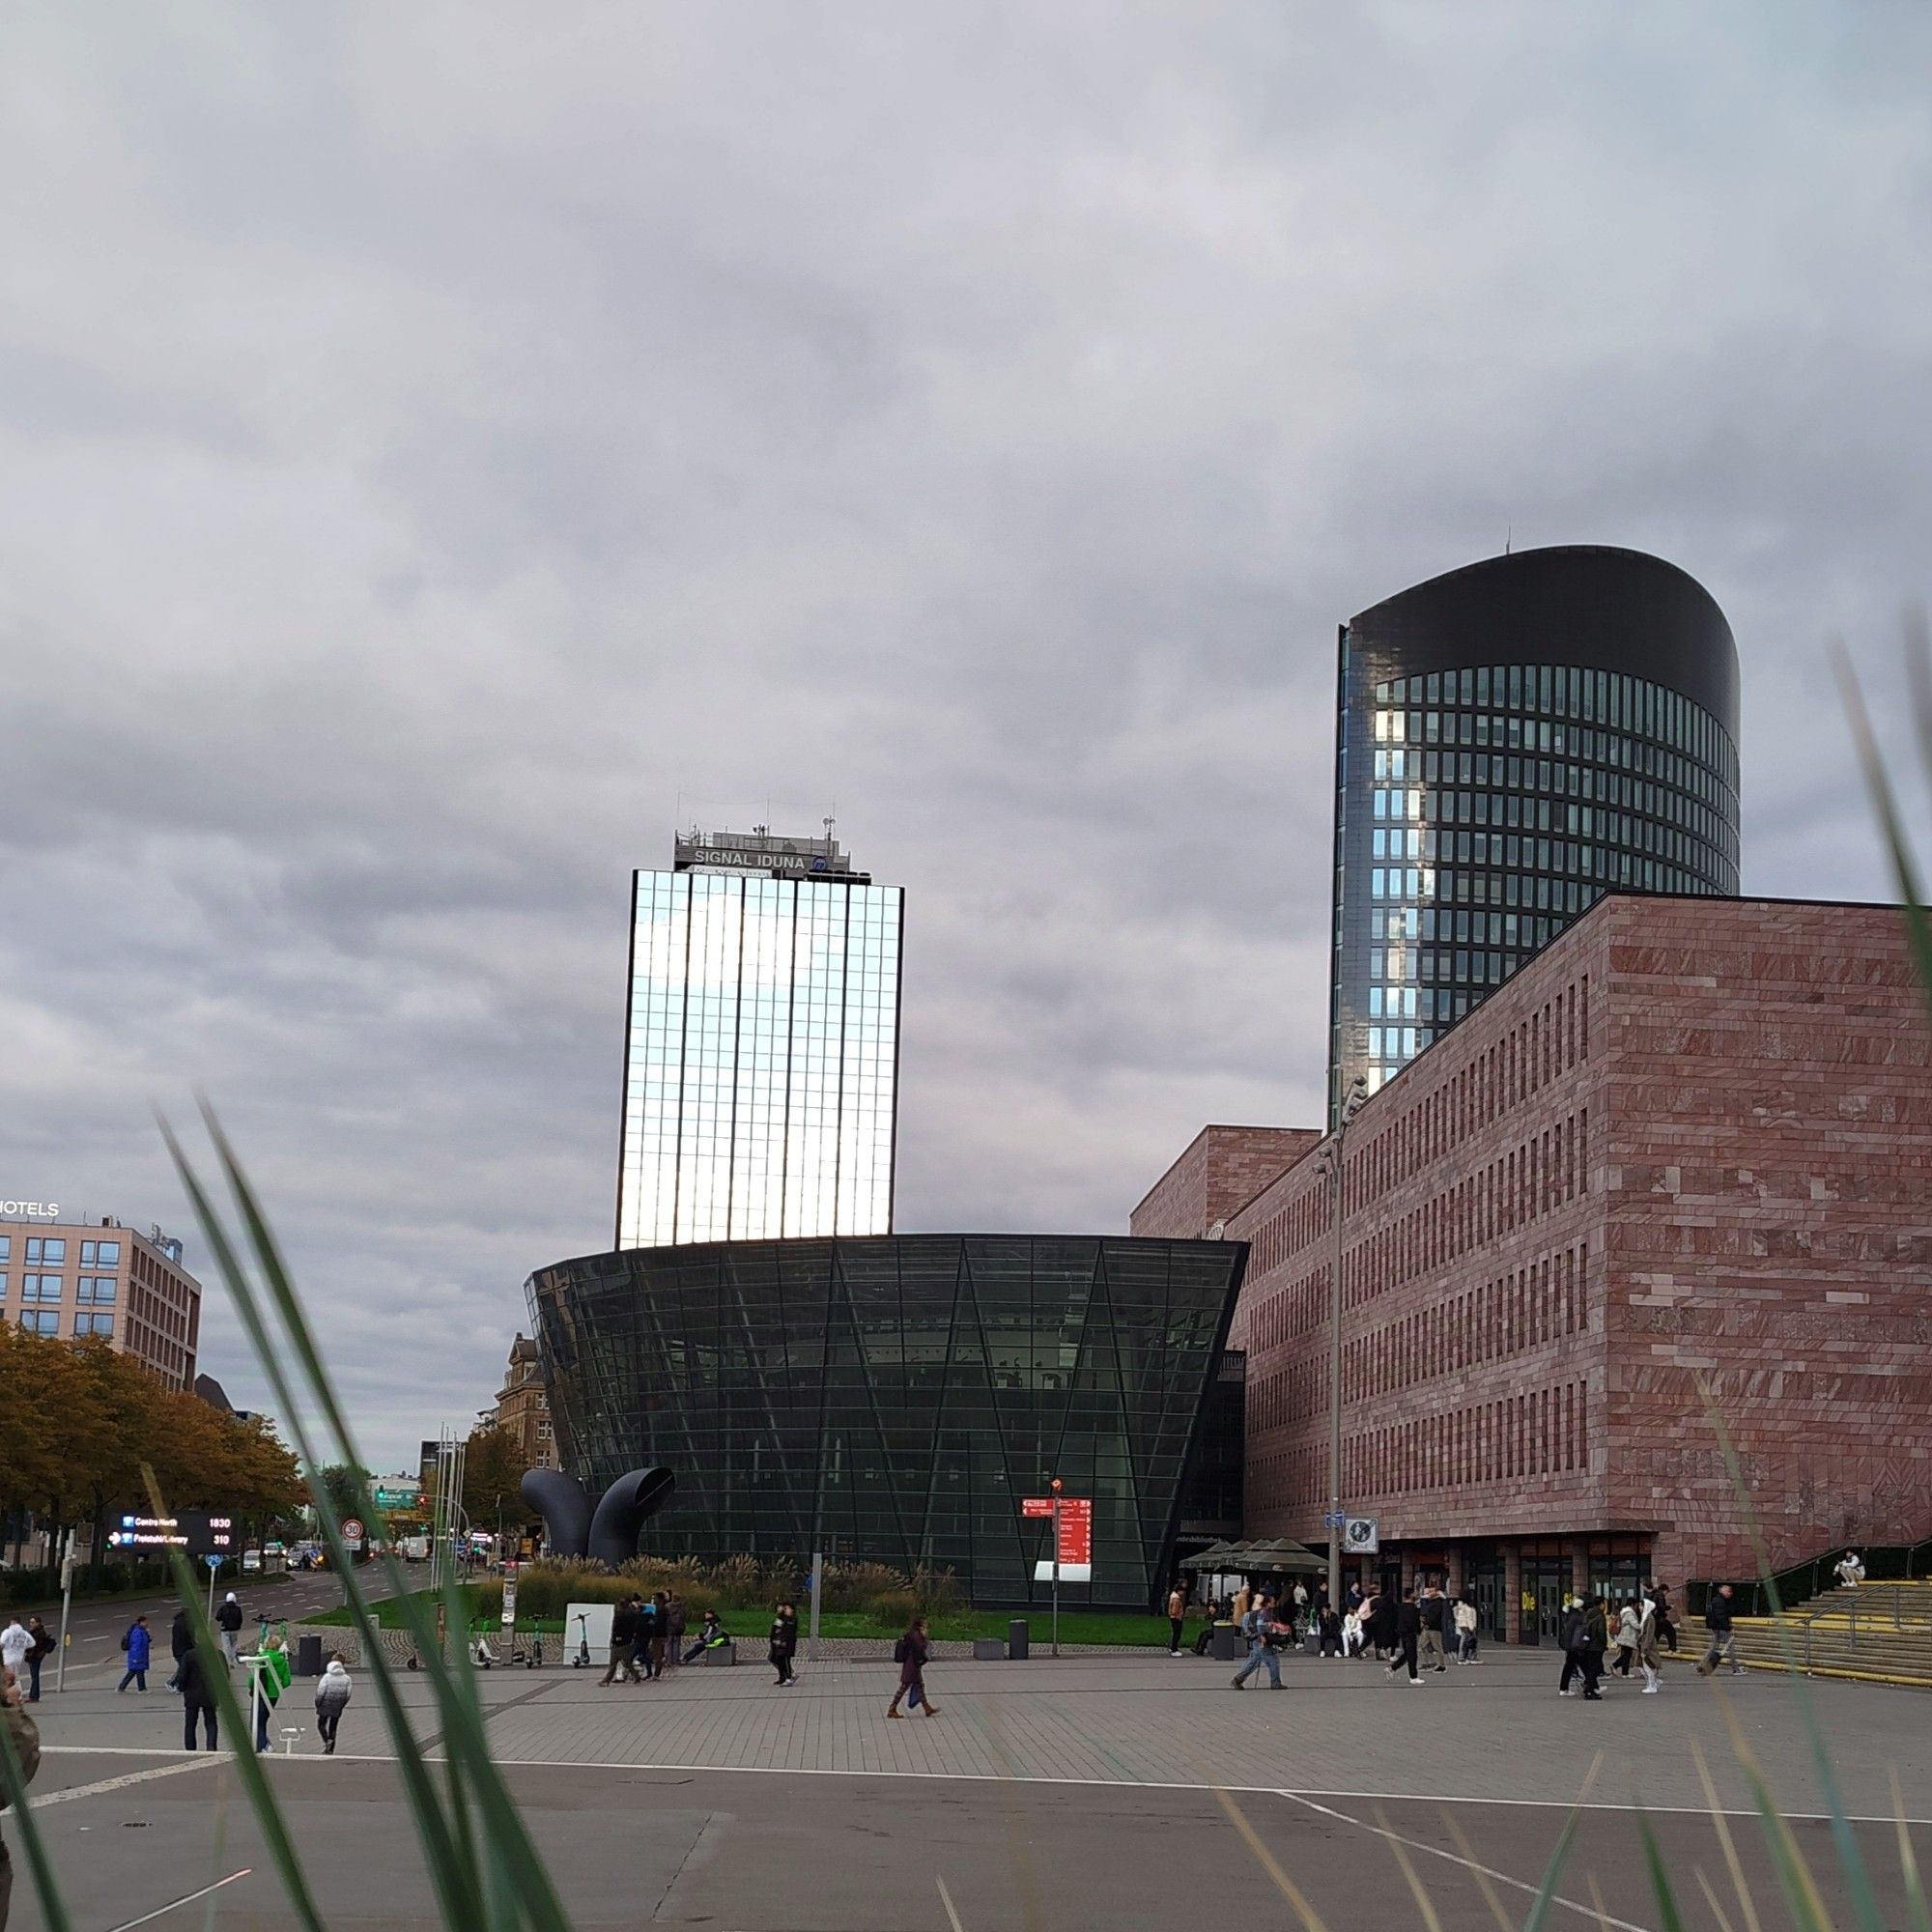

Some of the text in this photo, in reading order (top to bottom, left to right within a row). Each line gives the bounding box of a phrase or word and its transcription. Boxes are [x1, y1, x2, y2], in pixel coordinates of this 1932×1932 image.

[695, 851, 805, 869] SIGNAL IDUNA
[210, 1518, 231, 1528] 1830
[348, 1525, 358, 1534] 30
[213, 1534, 230, 1545] 310
